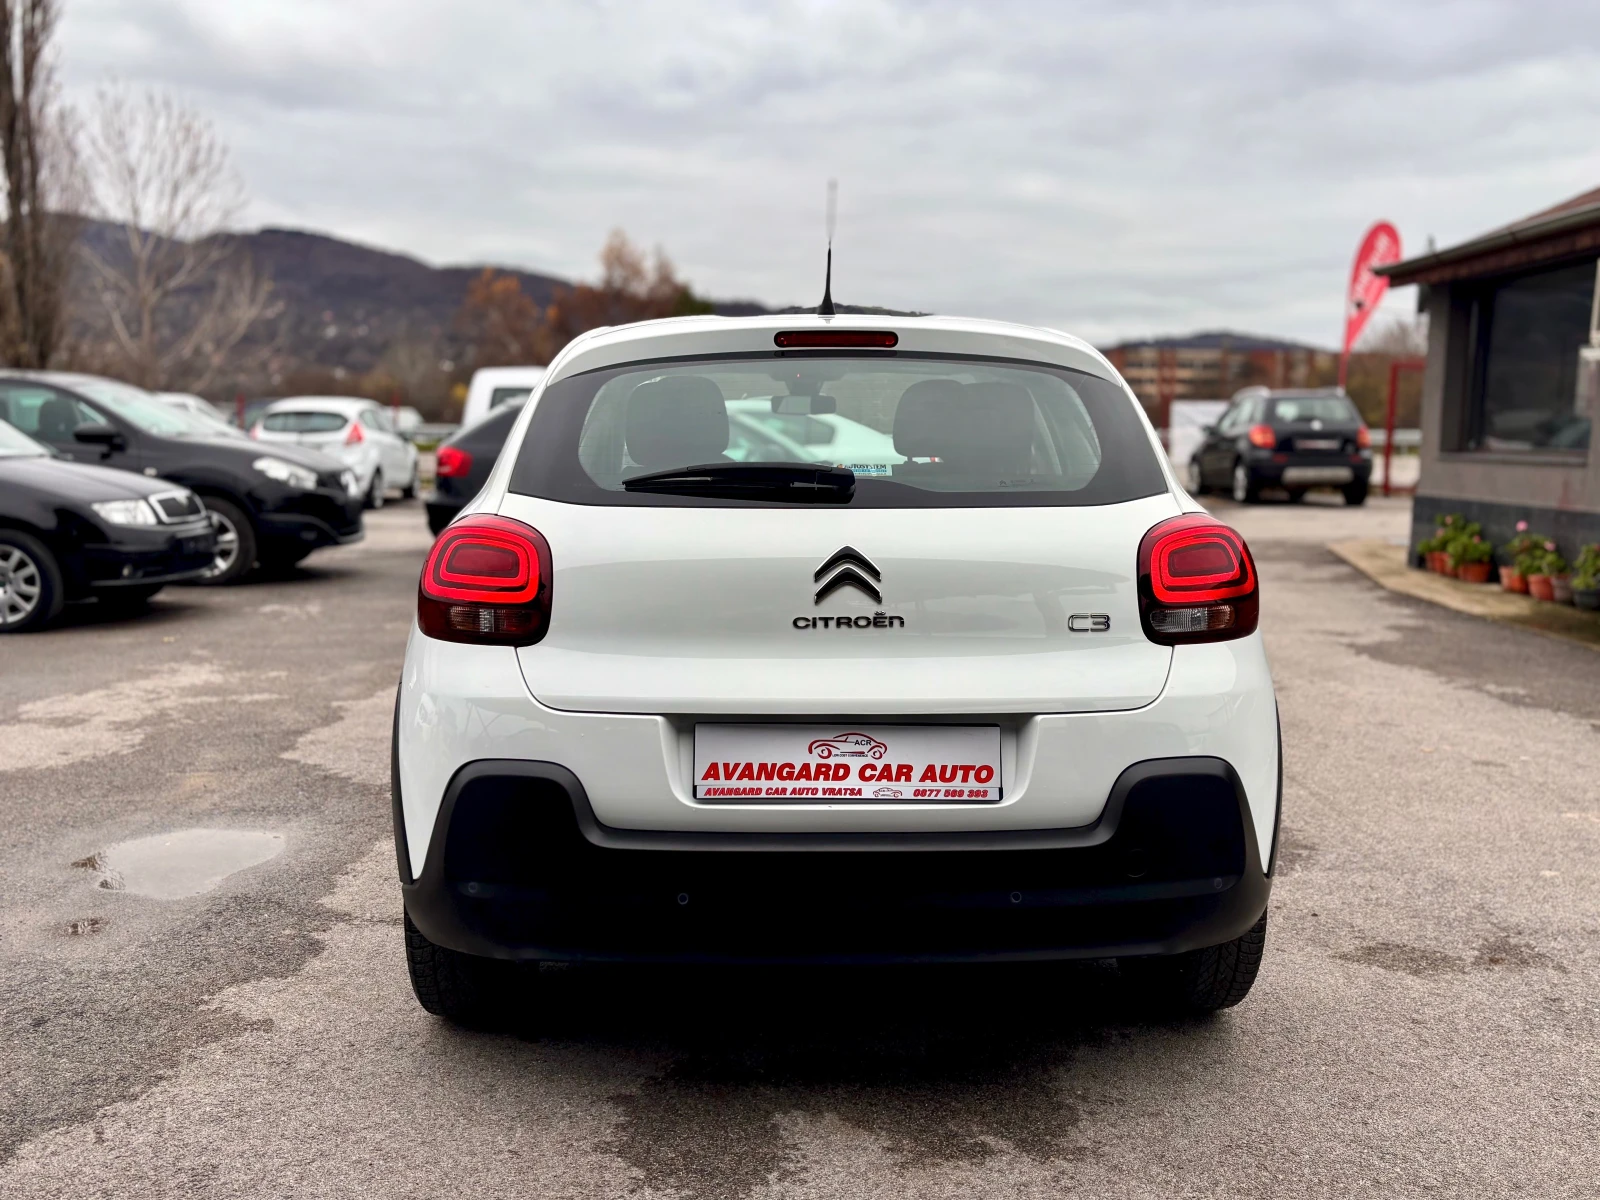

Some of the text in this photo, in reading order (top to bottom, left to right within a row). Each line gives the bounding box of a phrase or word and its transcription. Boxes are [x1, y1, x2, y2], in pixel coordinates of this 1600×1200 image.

[1068, 612, 1111, 632] C3
[701, 762, 994, 783] AVANGARD CAR AUTO
[704, 787, 863, 797] AVANGARD CAR AUTO VRATSA
[913, 789, 941, 797] 0877
